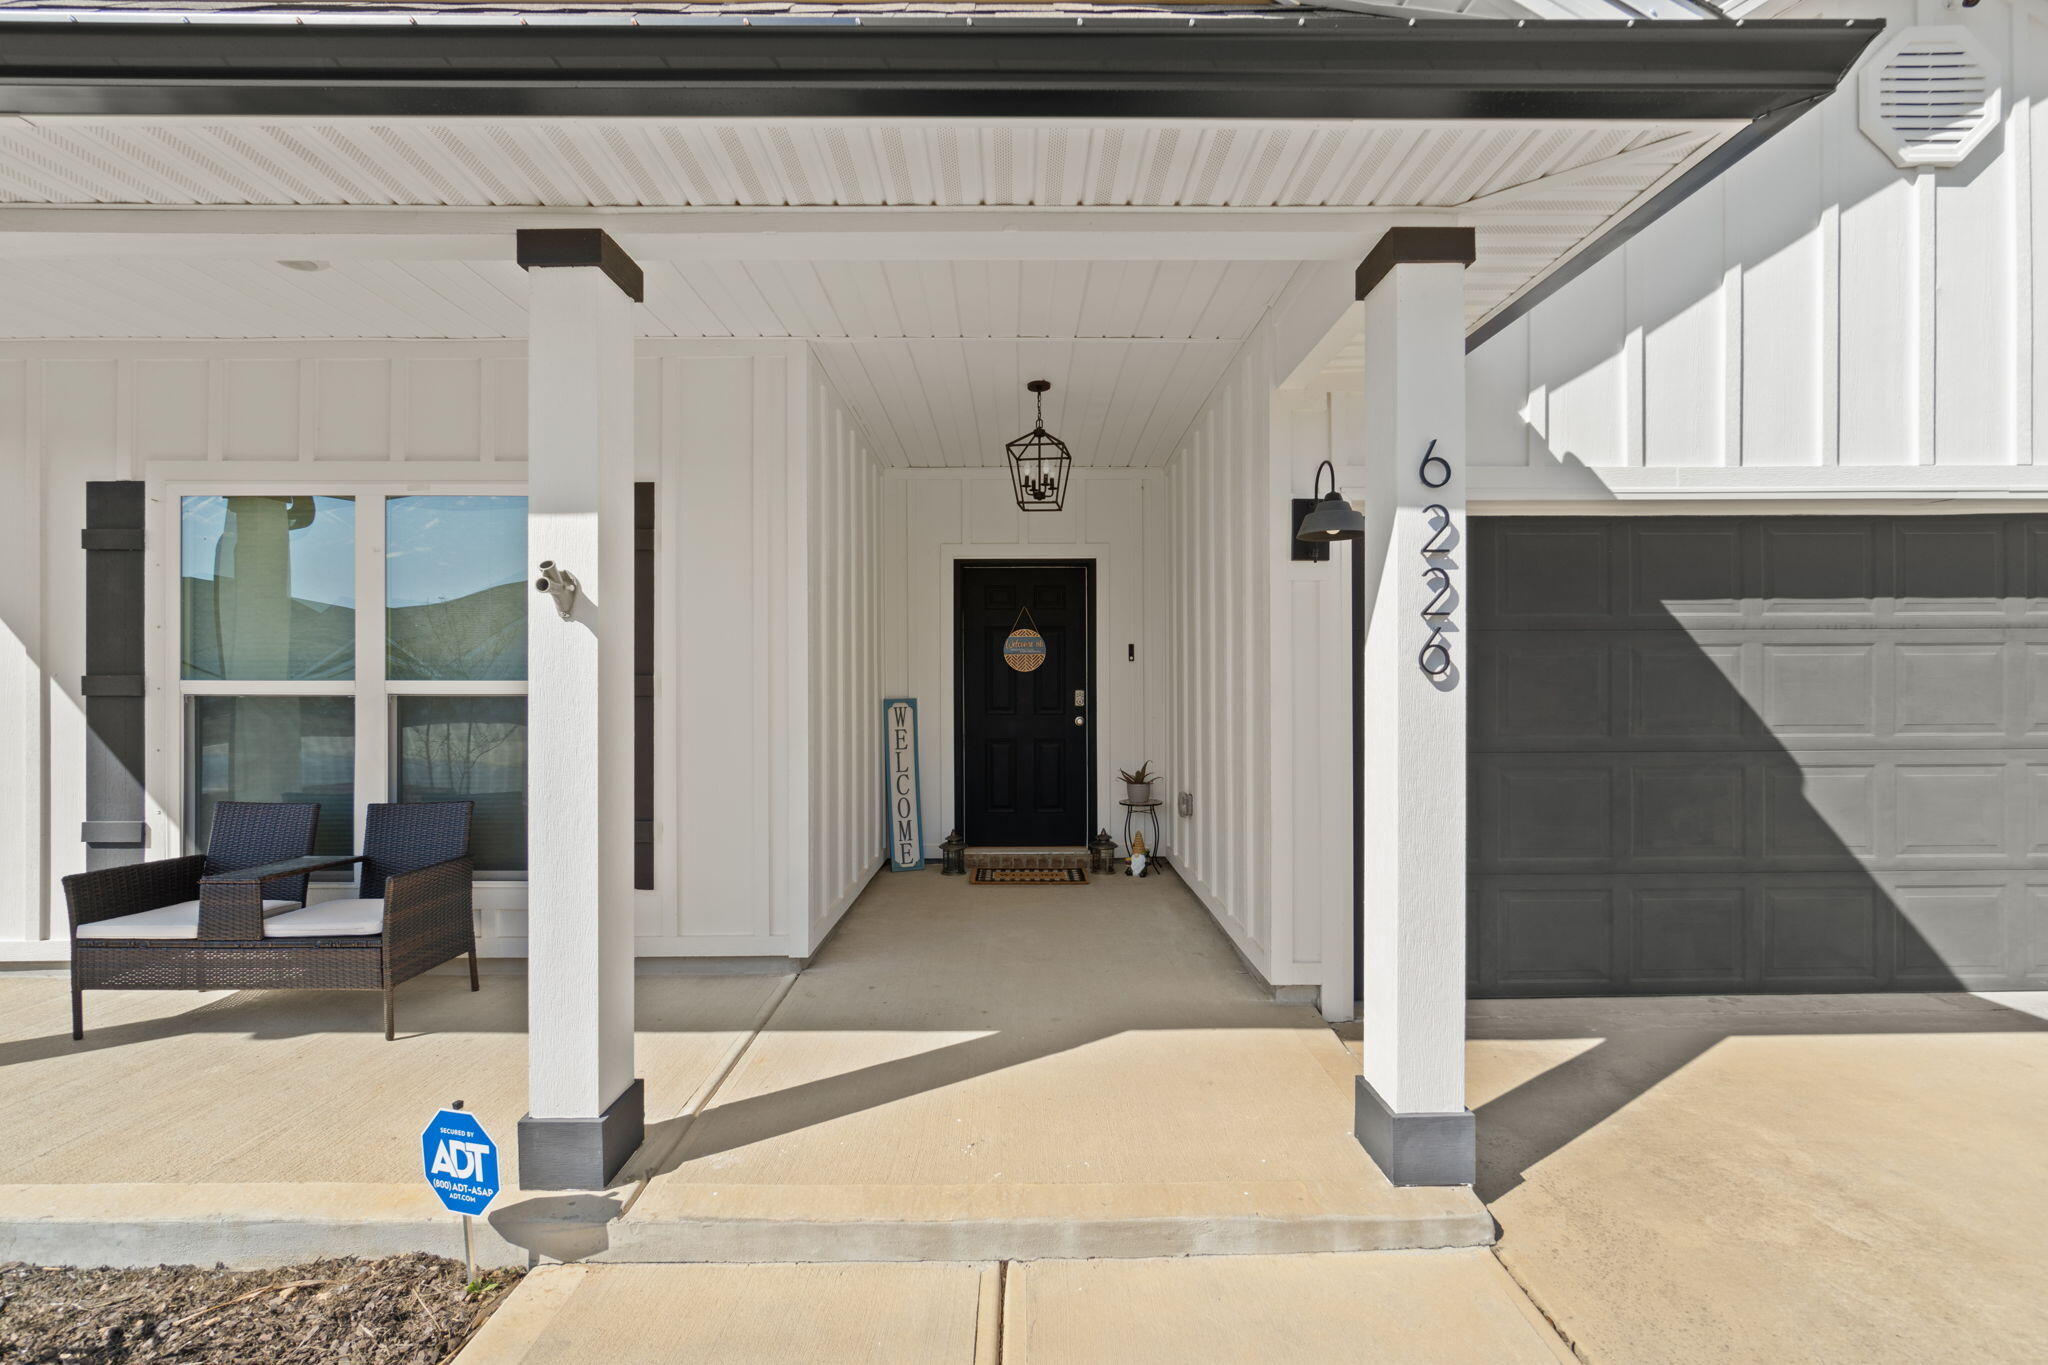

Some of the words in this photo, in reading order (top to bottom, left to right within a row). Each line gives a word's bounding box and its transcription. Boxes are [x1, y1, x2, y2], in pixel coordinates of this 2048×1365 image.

[1418, 439, 1451, 675] 6226
[893, 706, 914, 865] WELCOME
[440, 1127, 466, 1137] SECURED
[431, 1138, 490, 1182] ADT
[433, 1178, 452, 1191] (800)
[452, 1183, 494, 1197] ADT-ASAP
[449, 1193, 476, 1203] ADT.COM
